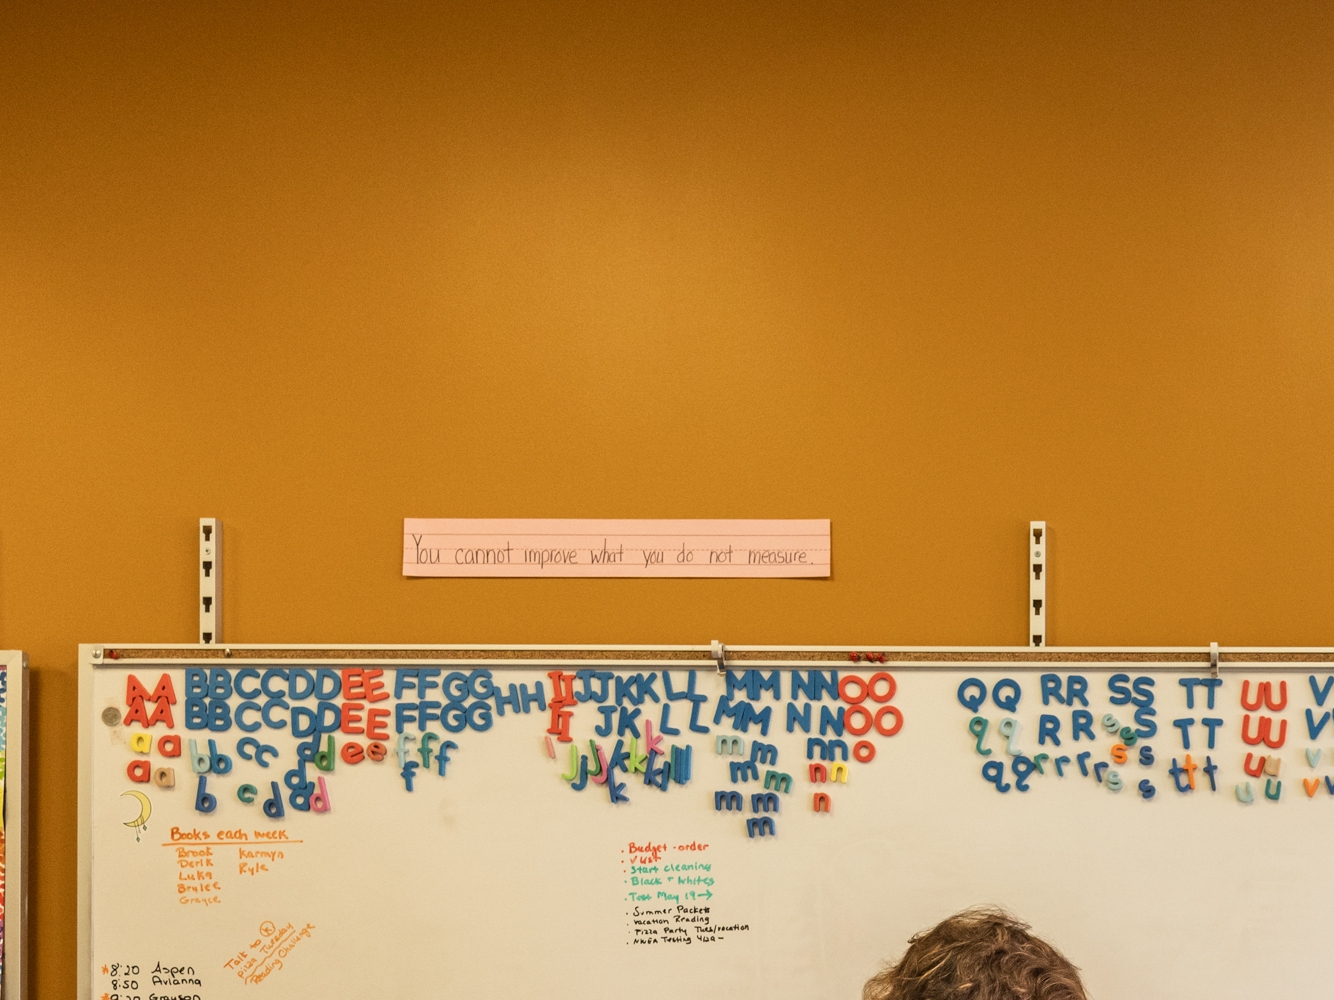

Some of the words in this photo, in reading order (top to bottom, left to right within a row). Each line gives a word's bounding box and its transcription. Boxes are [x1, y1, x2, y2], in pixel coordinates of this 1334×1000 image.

[412, 534, 440, 565] You
[455, 541, 514, 565] cannot
[524, 546, 578, 569] improve
[590, 538, 624, 565] what
[643, 549, 664, 568] you
[677, 543, 694, 563] do
[709, 545, 733, 563] not
[748, 549, 814, 565] measure.
[170, 827, 210, 841] Books
[217, 829, 248, 840] each
[254, 829, 289, 840] week
[628, 842, 667, 858] Budget
[657, 891, 679, 904] May
[664, 927, 687, 936] Party
[223, 951, 248, 970] Talk
[110, 963, 140, 977] 8:20
[151, 961, 195, 978] Aspen
[111, 979, 139, 990] 8:50
